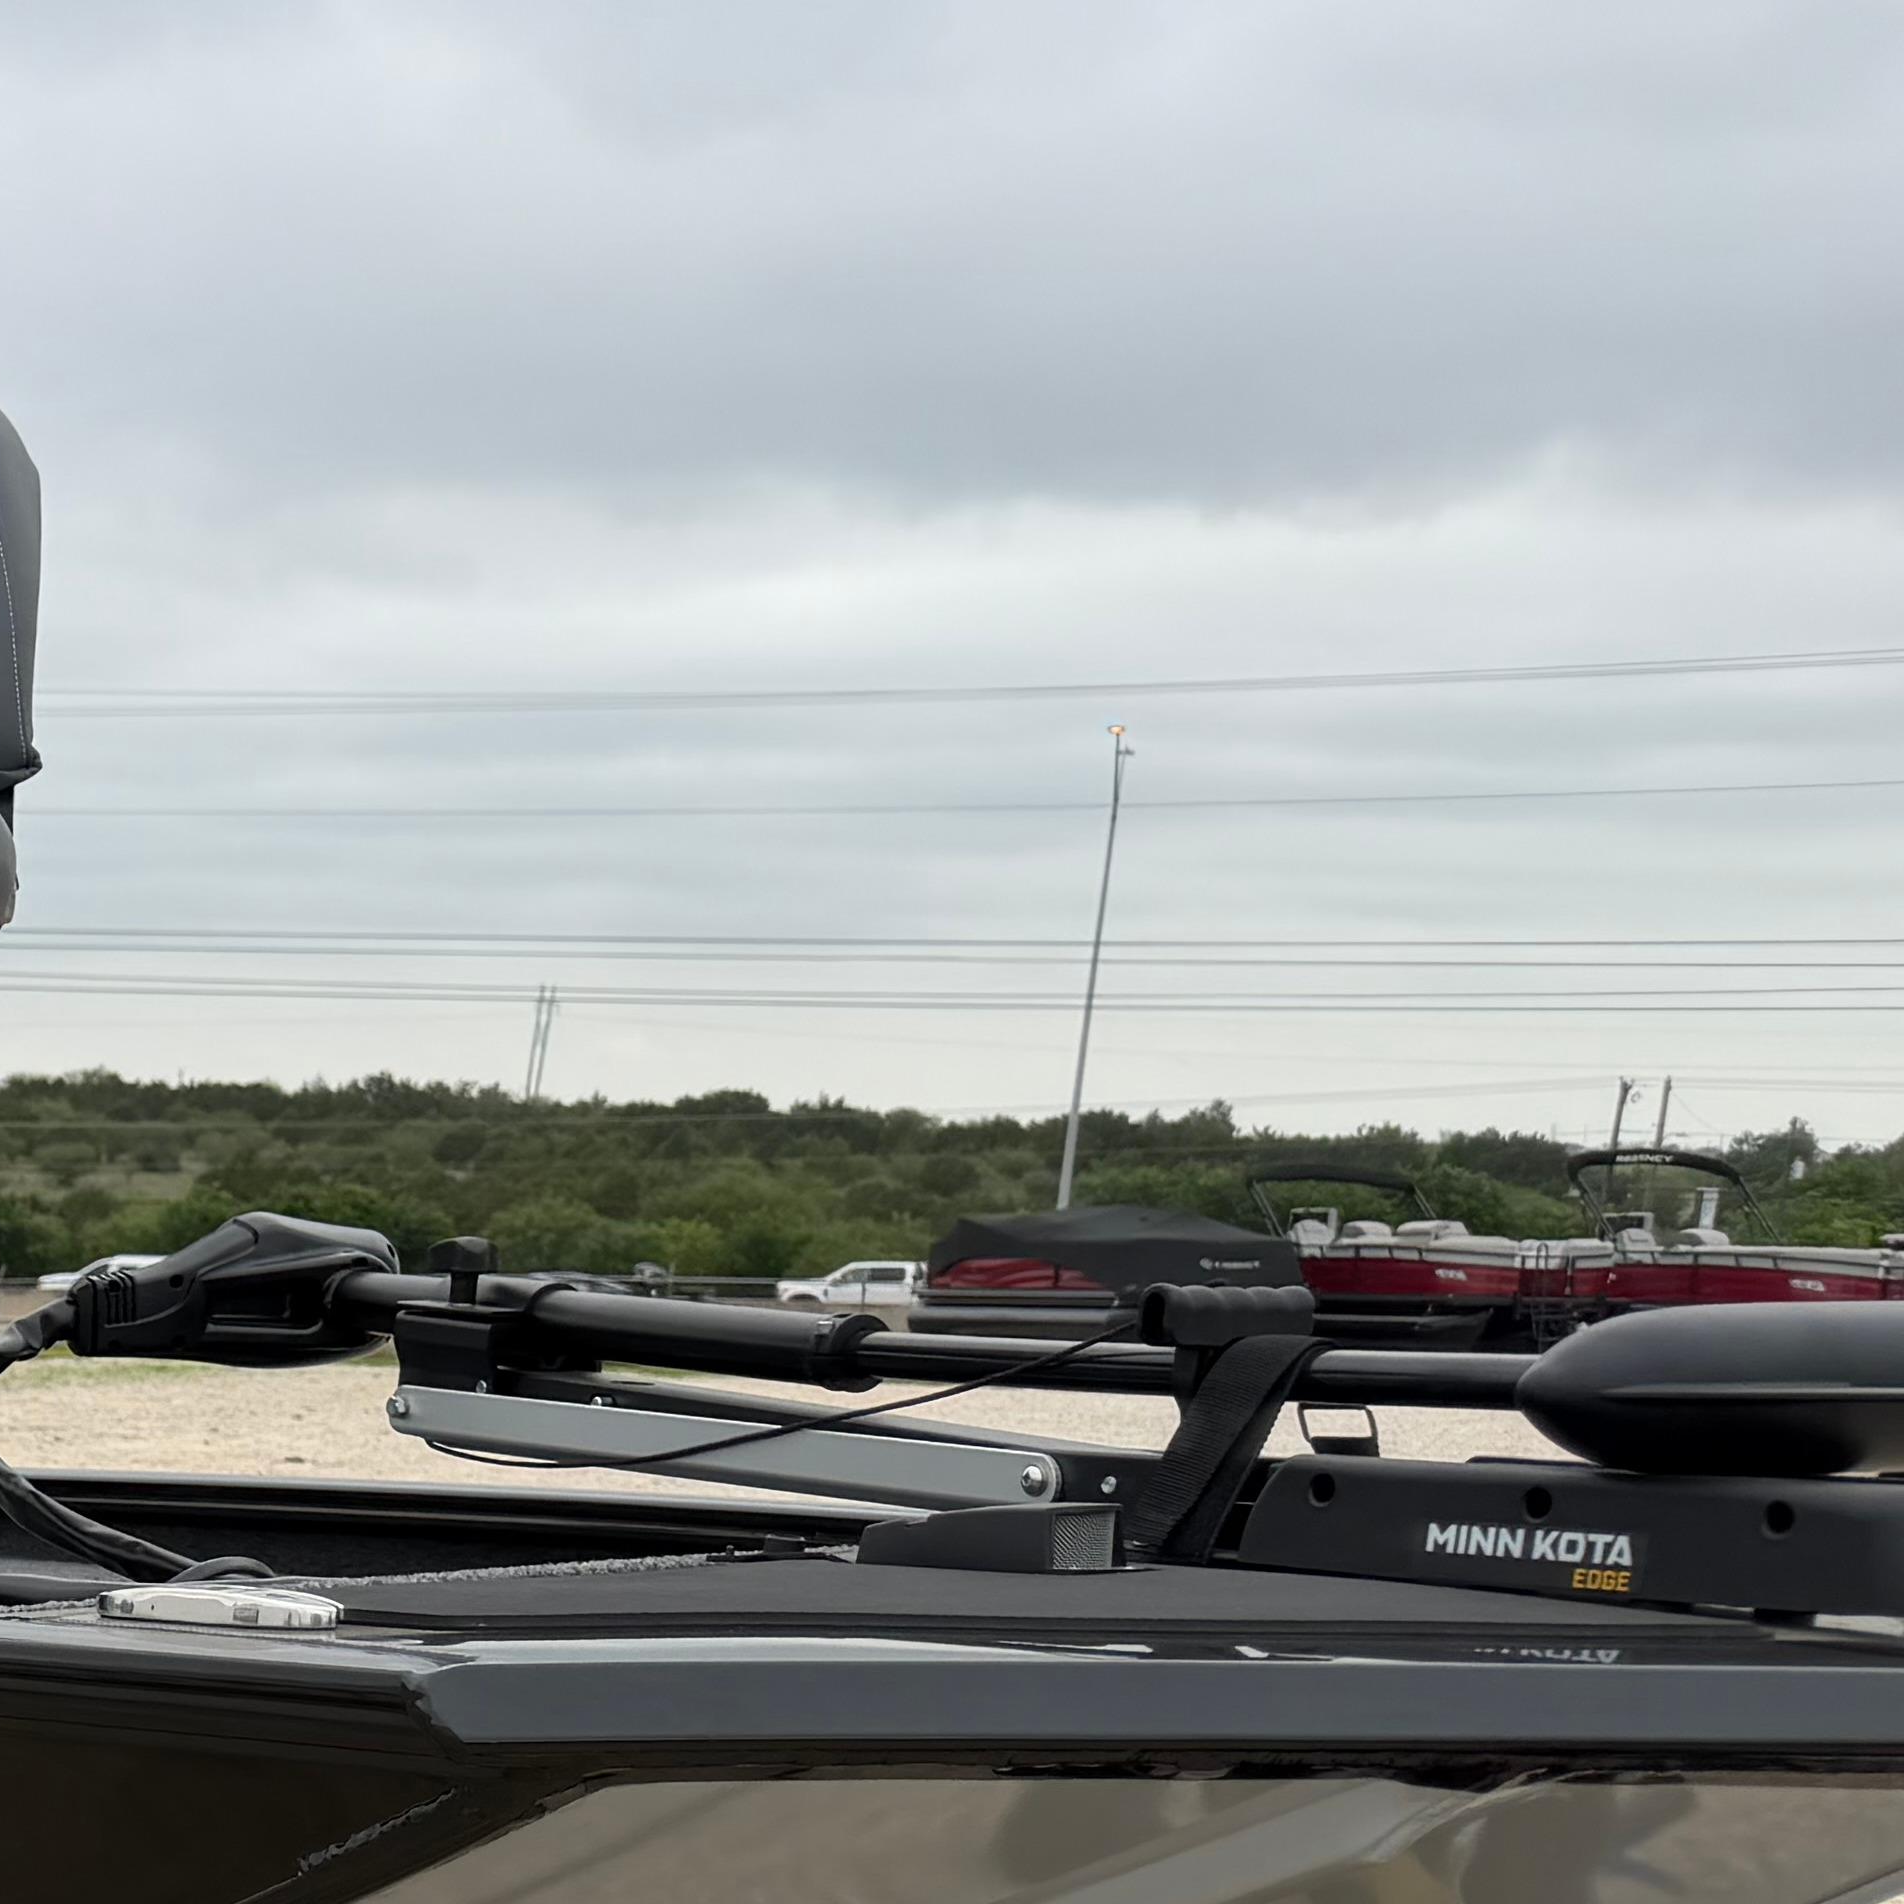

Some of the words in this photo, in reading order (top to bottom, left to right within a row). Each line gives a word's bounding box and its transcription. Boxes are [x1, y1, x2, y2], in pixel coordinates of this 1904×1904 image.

[1425, 1522, 1526, 1559] MINN
[1530, 1528, 1633, 1567] KOTA
[1571, 1567, 1632, 1593] EDGE
